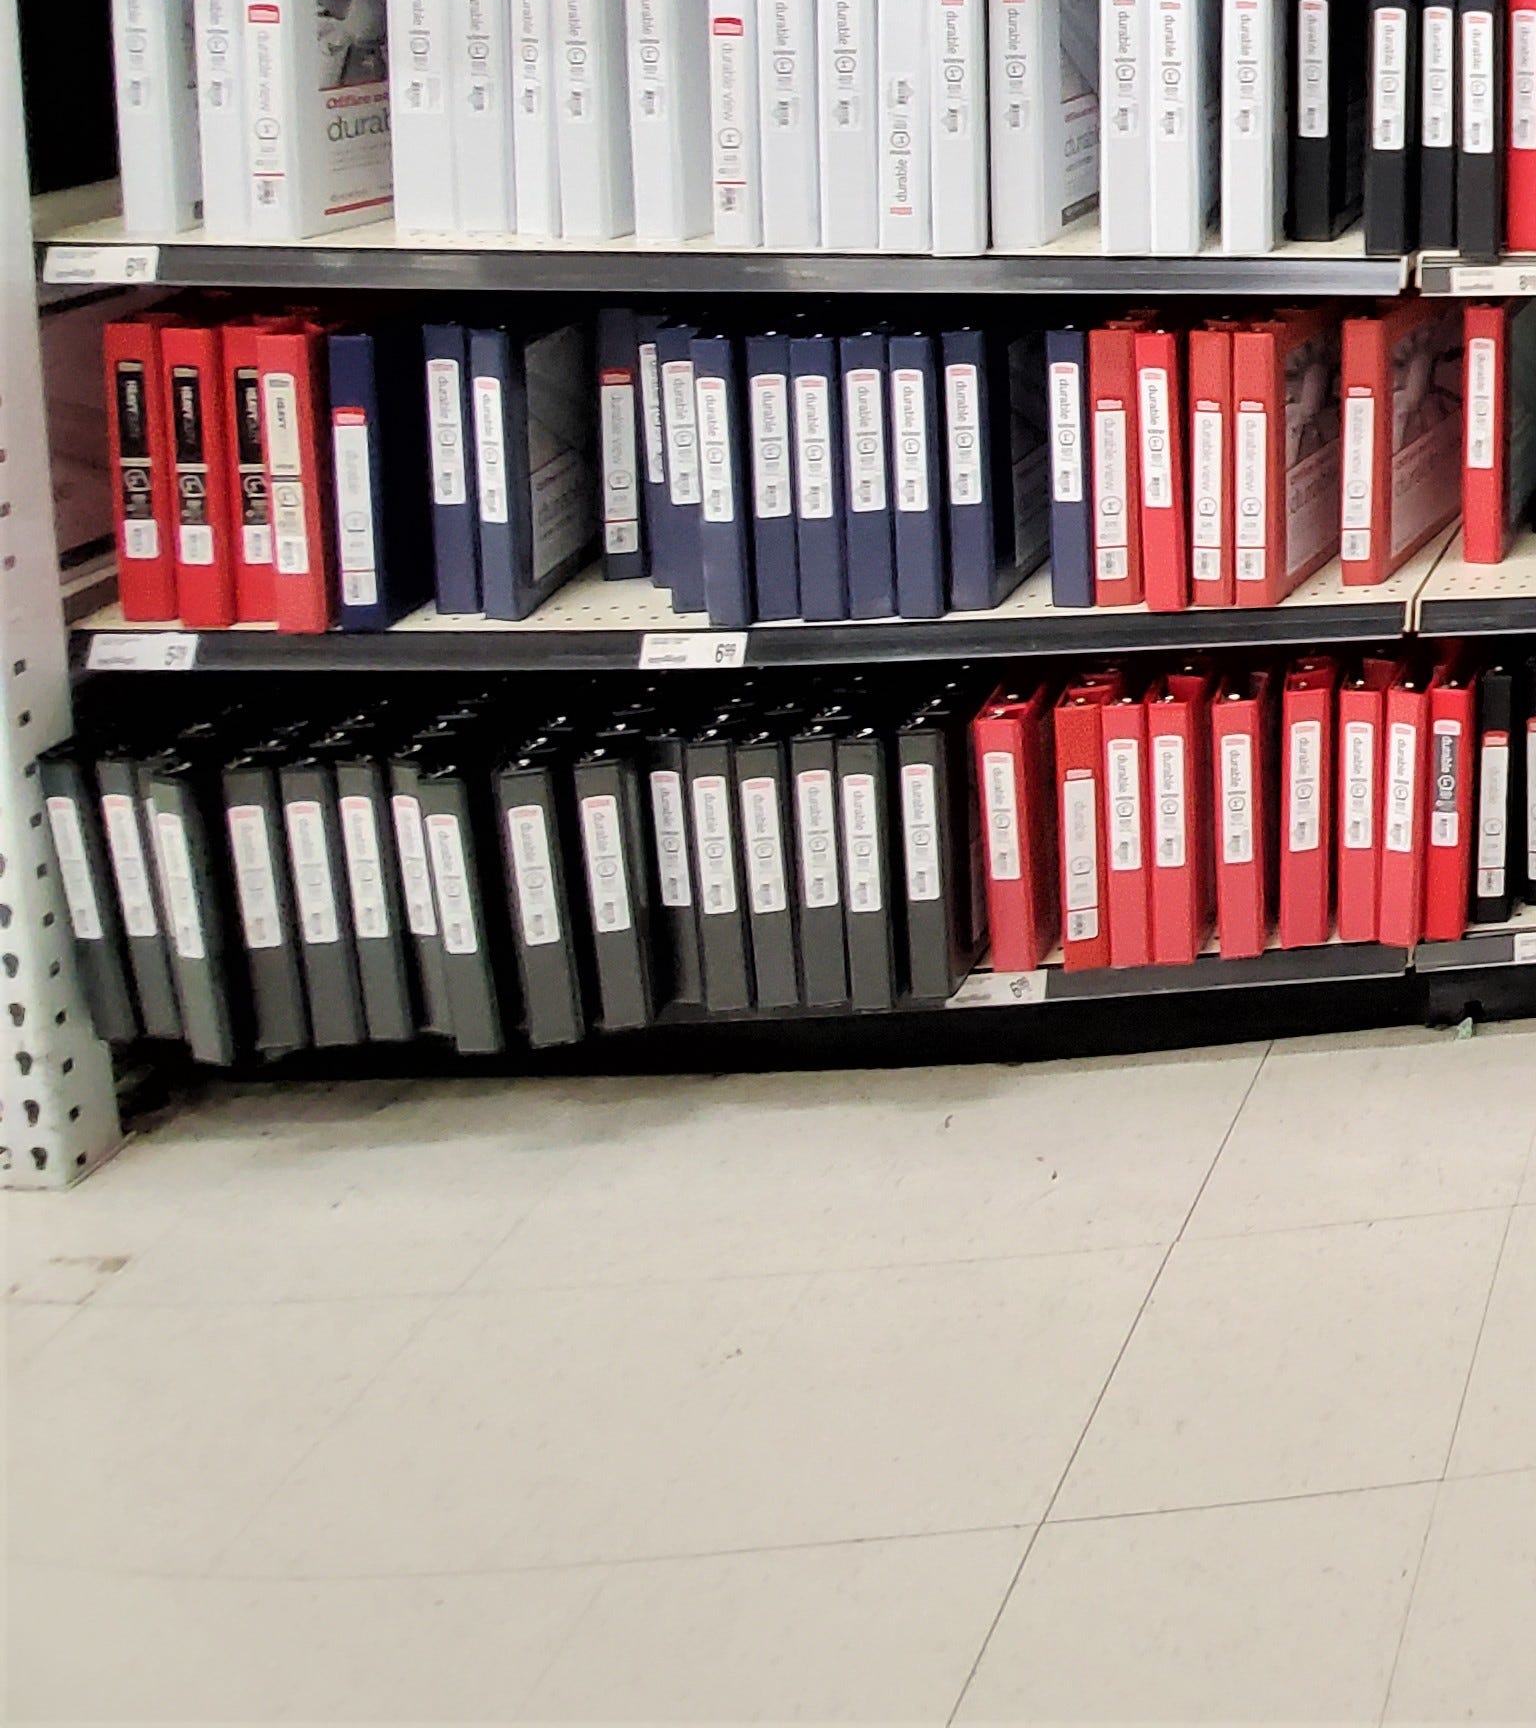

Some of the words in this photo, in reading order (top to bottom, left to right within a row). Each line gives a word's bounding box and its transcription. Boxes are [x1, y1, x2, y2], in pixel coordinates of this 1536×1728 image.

[775, 2, 787, 47] durable
[837, 1, 848, 46] durable
[945, 10, 957, 57] durable
[1007, 8, 1019, 52] durable
[1117, 11, 1129, 54] durable
[673, 377, 685, 420] durable
[705, 395, 718, 436] durable
[762, 390, 774, 433] durable
[806, 392, 818, 435] durable
[858, 386, 871, 429] durable
[904, 385, 915, 427] durable
